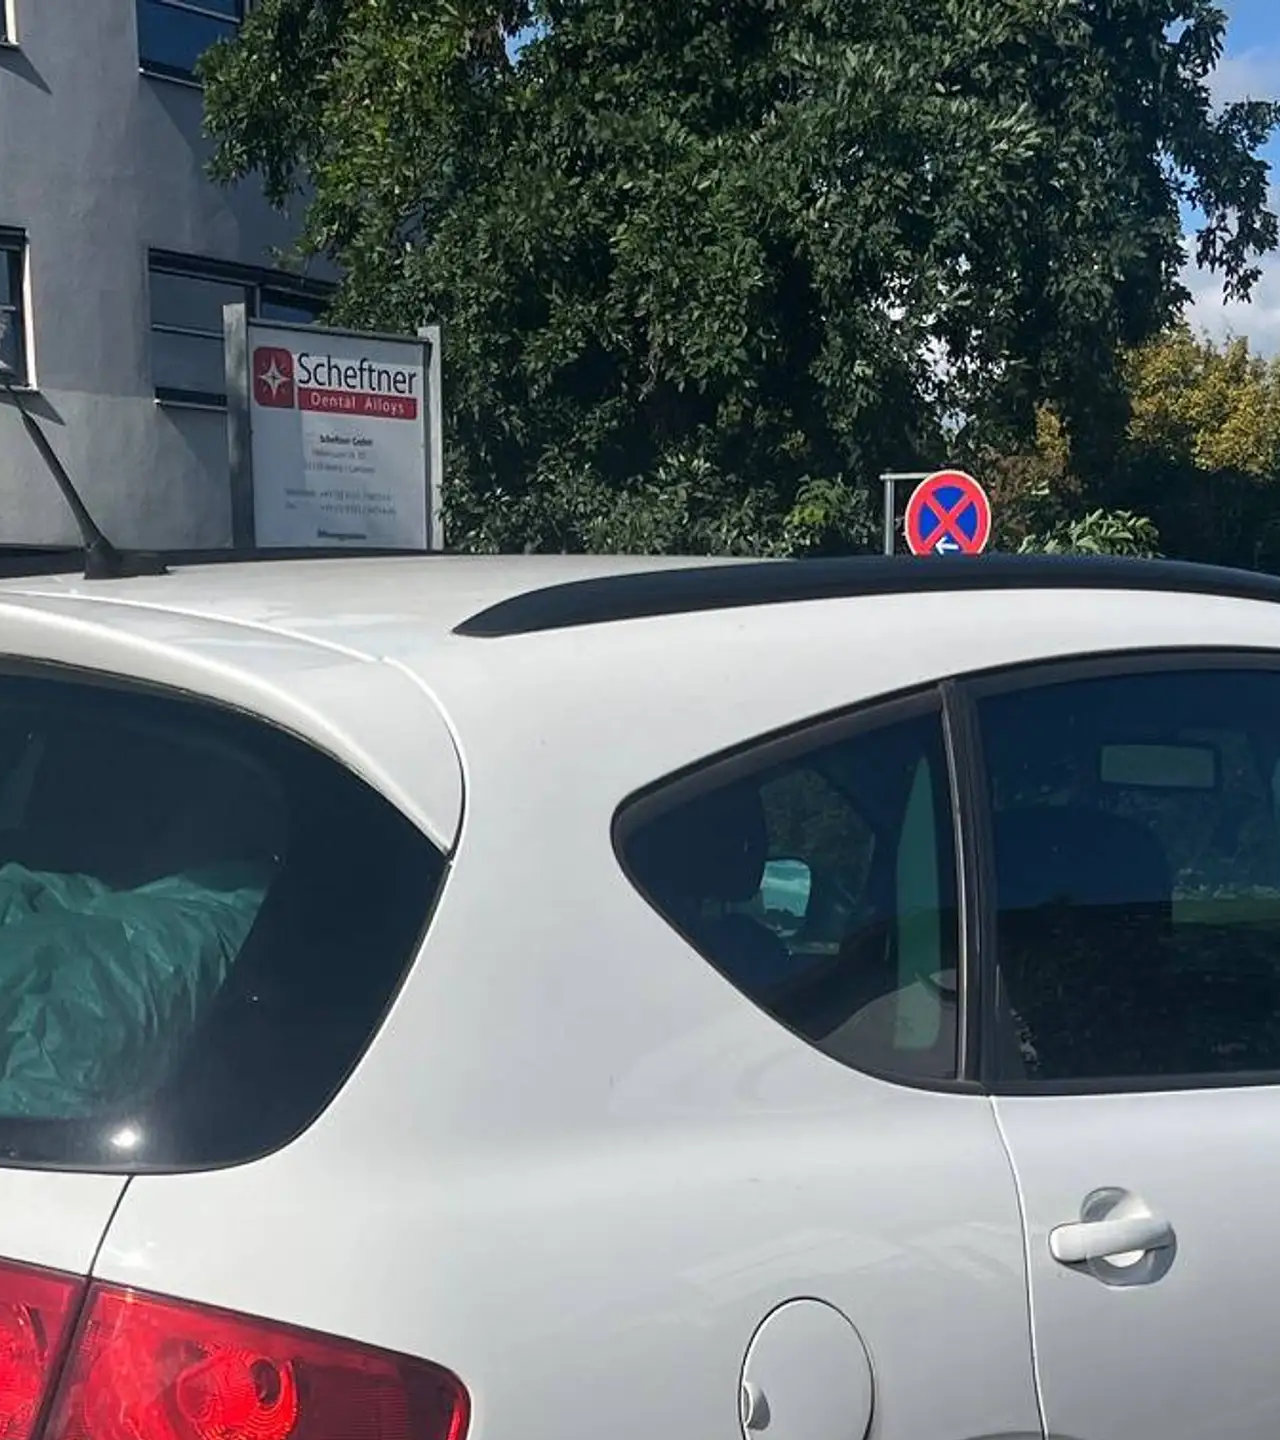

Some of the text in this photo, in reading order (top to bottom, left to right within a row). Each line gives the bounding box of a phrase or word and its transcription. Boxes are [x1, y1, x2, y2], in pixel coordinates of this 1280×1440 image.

[297, 353, 417, 394] Scheftner
[311, 394, 405, 415] Dental Alloys
